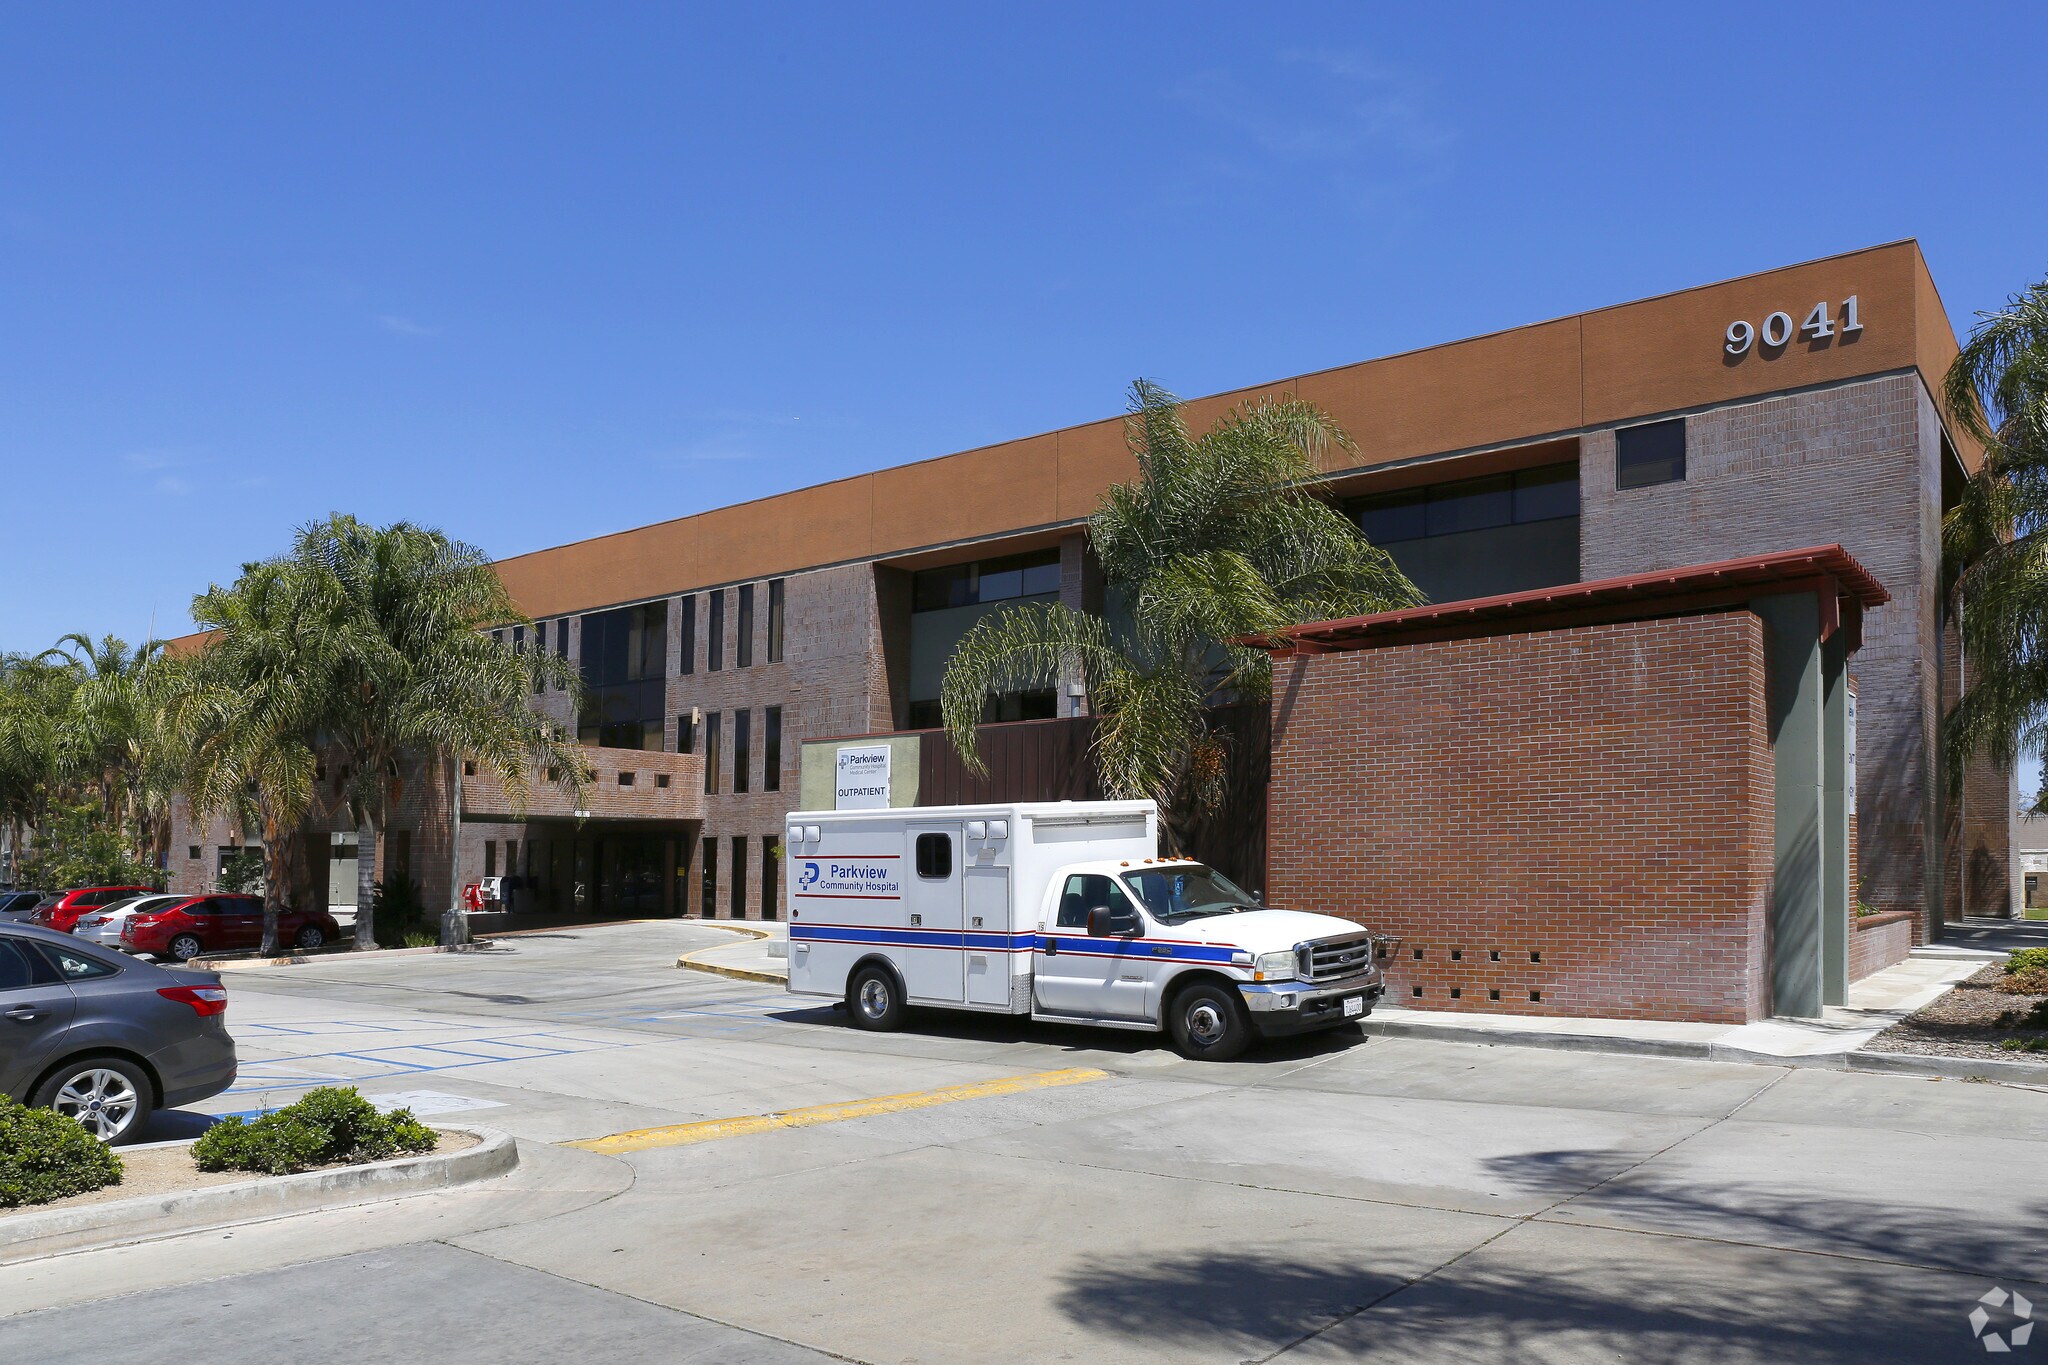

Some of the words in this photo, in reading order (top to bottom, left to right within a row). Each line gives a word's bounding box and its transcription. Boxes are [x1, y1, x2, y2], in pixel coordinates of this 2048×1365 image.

[1726, 295, 1863, 355] 9041
[850, 754, 885, 764] Parkview
[838, 787, 885, 797] OUTPATIENT
[831, 865, 887, 878] Parkview
[820, 881, 863, 892] Community
[866, 882, 899, 892] Hospital
